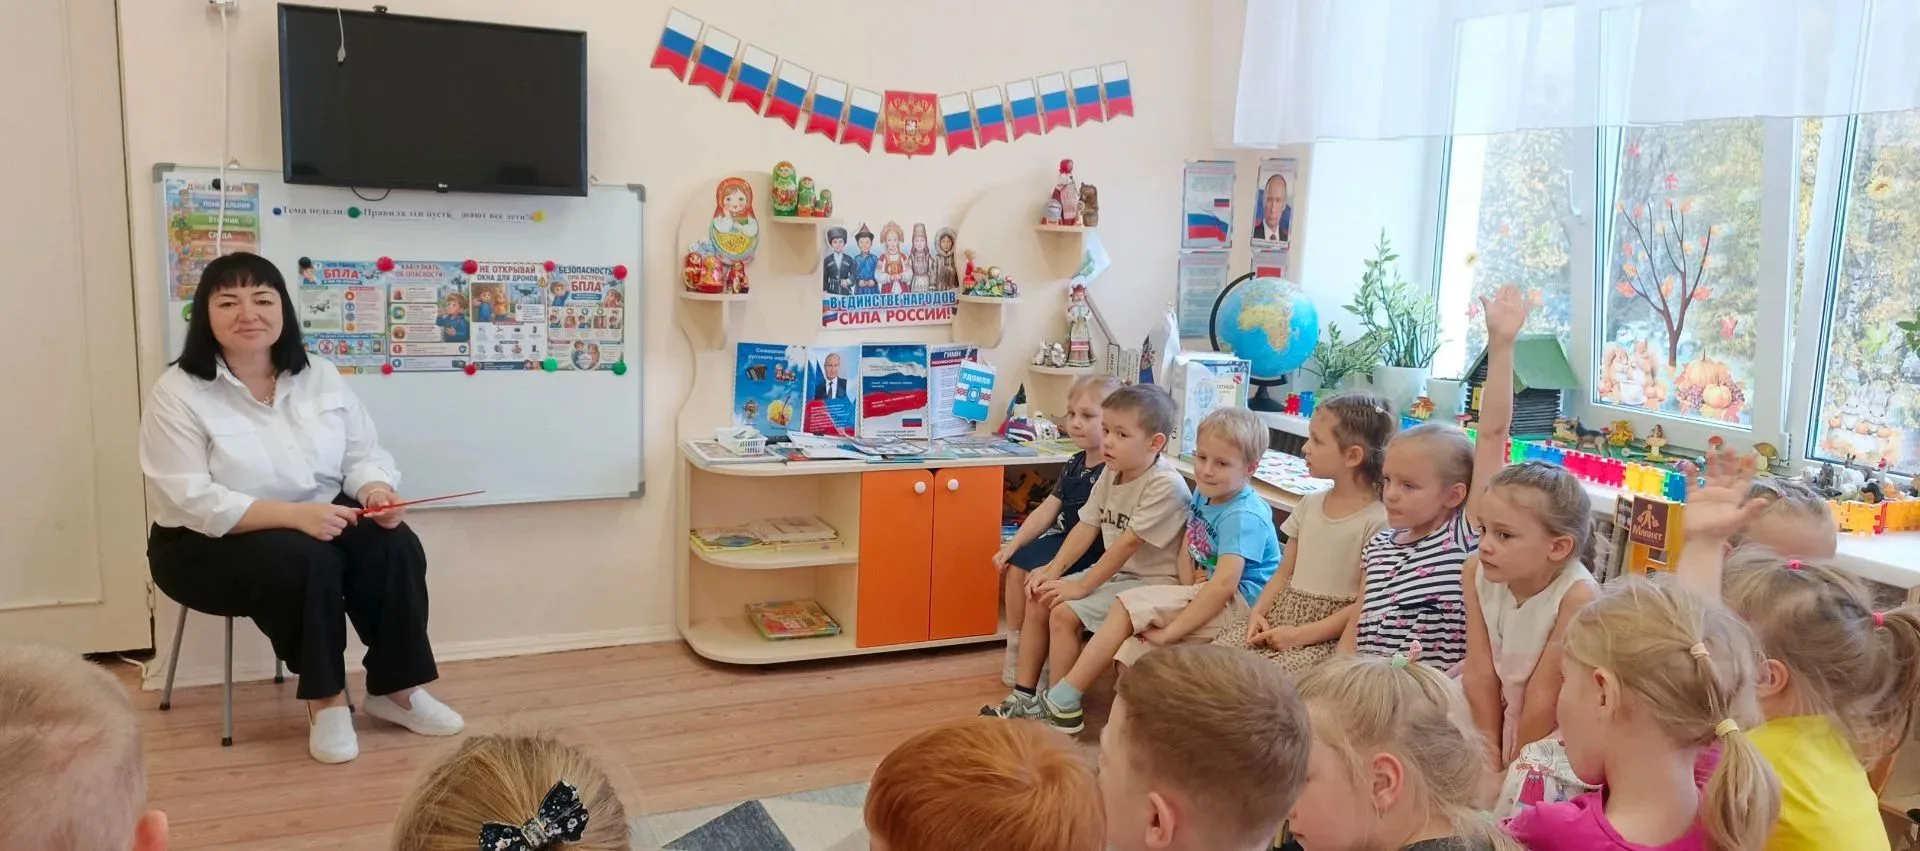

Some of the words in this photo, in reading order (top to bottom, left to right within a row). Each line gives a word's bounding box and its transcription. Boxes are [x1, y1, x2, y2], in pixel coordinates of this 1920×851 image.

[283, 206, 306, 214] Тема
[324, 268, 359, 279] БПЛА
[479, 265, 489, 273] НЕ
[492, 265, 536, 274] ОТКРЫВАЙ
[558, 266, 613, 276] БЕЗОПАСНОСТЬ
[571, 281, 602, 292] БПЛА
[830, 296, 838, 309] В
[841, 294, 900, 309] ЕДИНСТВЕ
[903, 291, 956, 305] НАРОДОВ
[839, 309, 881, 325] СИЛА
[886, 306, 951, 322] РОССИИ!
[943, 350, 962, 359] ГИМН
[961, 372, 992, 385] УДОМЛЯ
